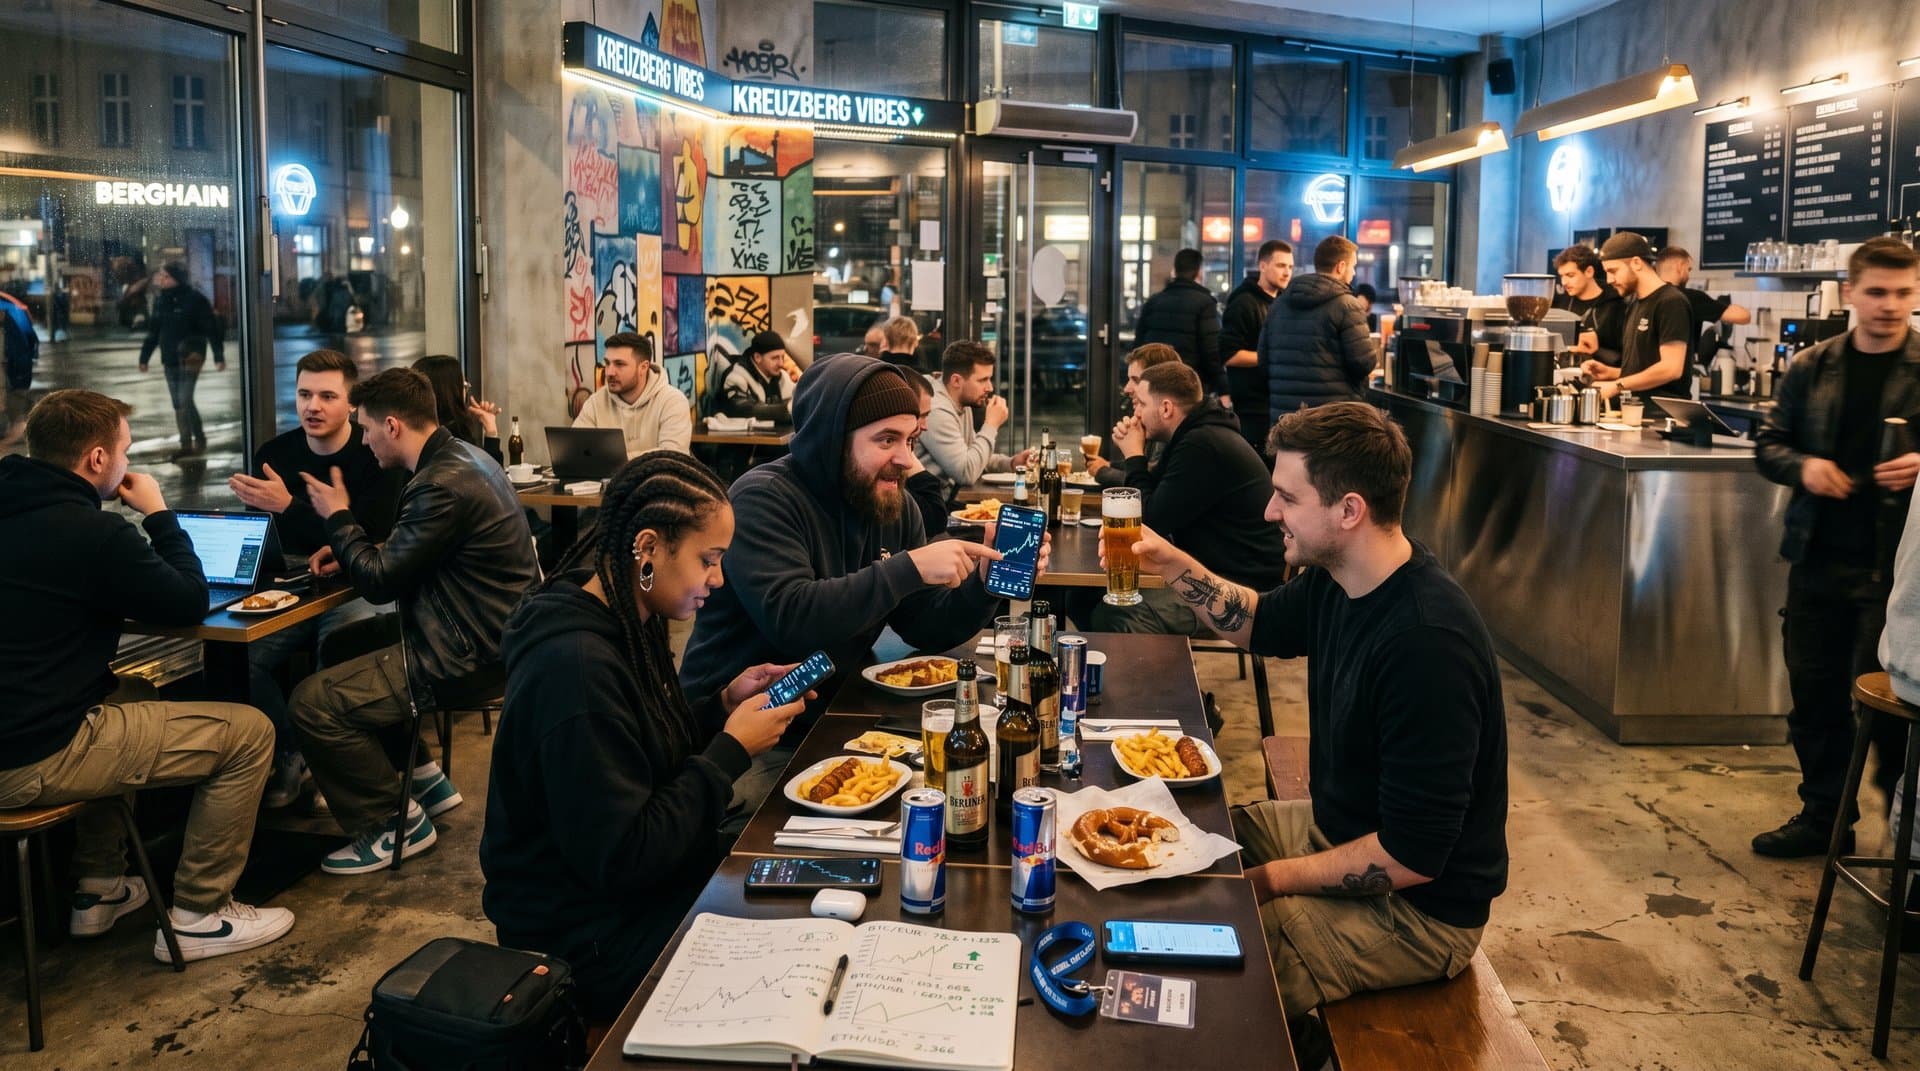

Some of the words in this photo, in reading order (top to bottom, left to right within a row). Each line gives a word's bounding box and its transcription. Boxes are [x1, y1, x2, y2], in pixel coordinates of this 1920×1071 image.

[596, 34, 671, 91] KREUZBERG
[672, 63, 705, 102] VIBES
[733, 84, 851, 122] KREUZBERG
[855, 96, 911, 127] VIBES
[95, 181, 230, 208] BERGHAIN
